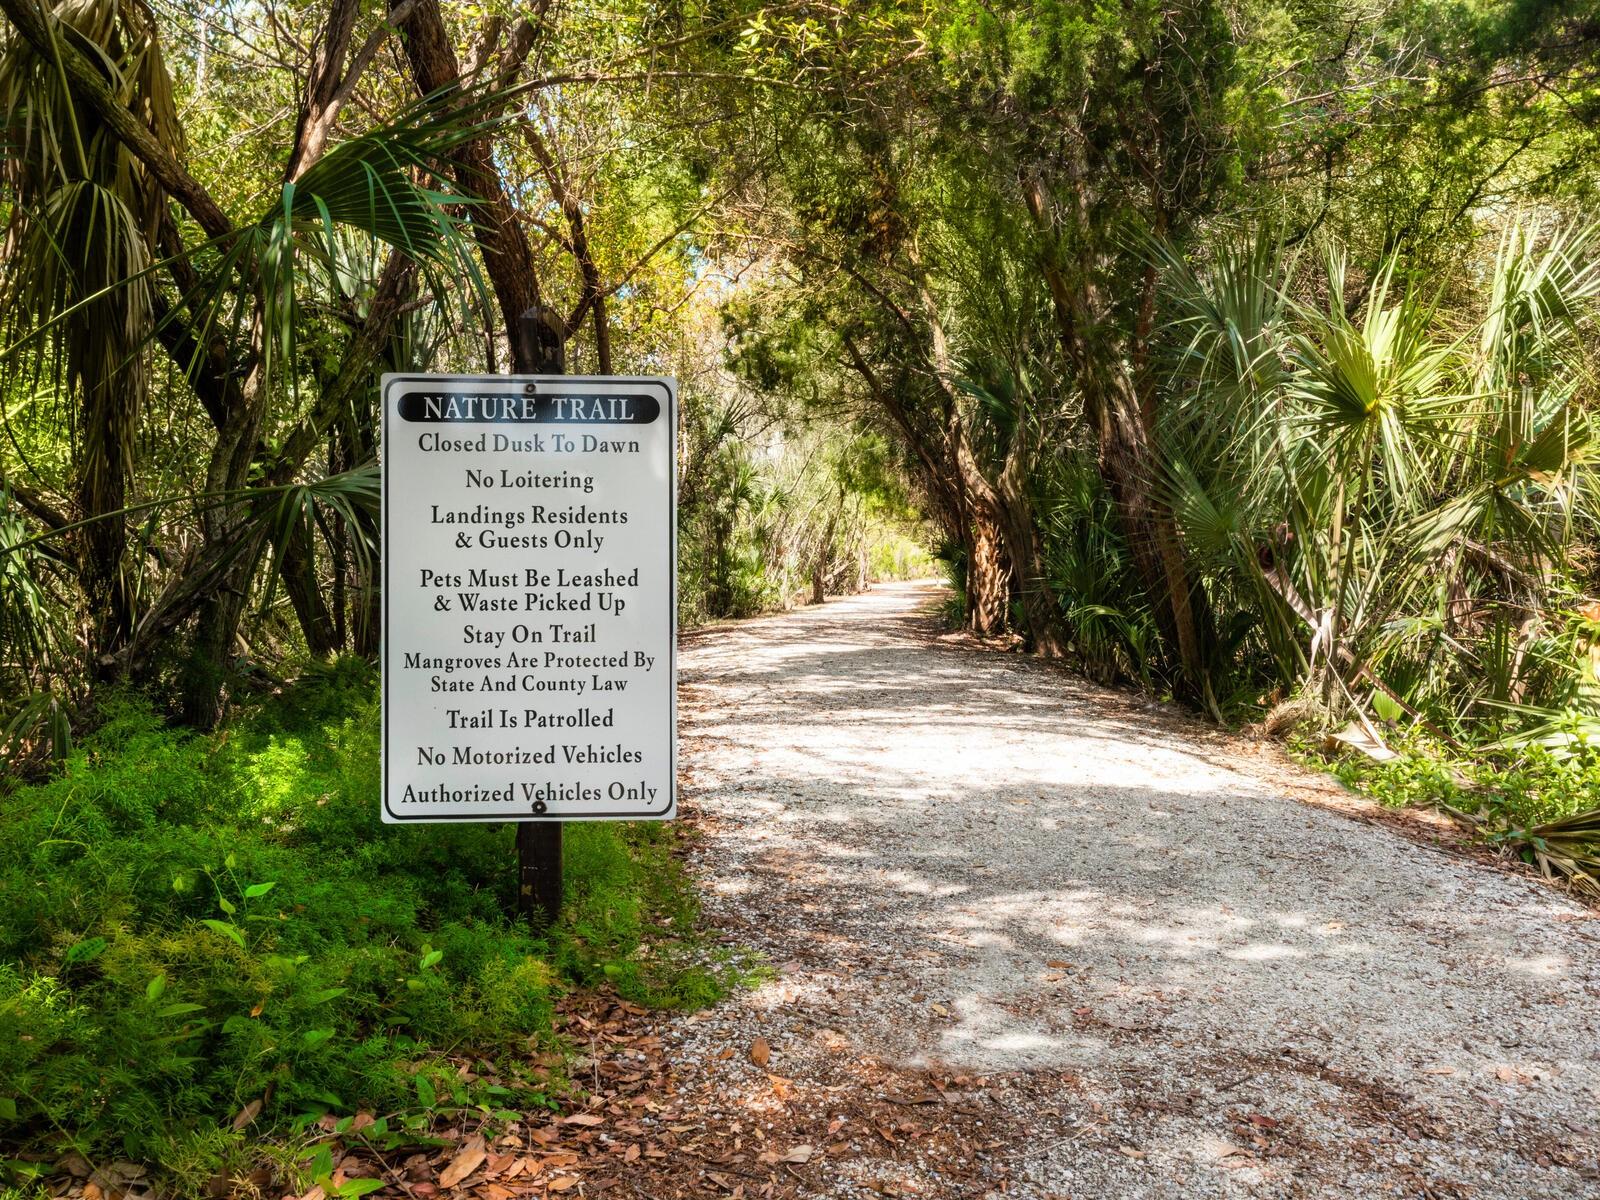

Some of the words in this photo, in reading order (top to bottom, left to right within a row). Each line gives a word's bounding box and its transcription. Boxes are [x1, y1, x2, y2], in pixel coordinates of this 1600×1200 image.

[424, 396, 536, 420] NATURE
[552, 398, 634, 420] TRAIL
[418, 433, 486, 452] Closed
[493, 434, 544, 452] Dusk
[552, 434, 576, 452] To
[582, 434, 640, 453] Dawn
[466, 470, 494, 488] No
[500, 470, 594, 493] Loitering
[432, 506, 525, 528] Landings
[532, 506, 628, 524] Residents
[456, 532, 472, 548] &
[479, 530, 548, 548] Guests
[554, 530, 604, 553] Only
[420, 569, 461, 588] Pets
[468, 569, 517, 588] Must
[524, 569, 550, 587] Be
[557, 568, 638, 587] Leashed
[434, 595, 452, 612] &
[458, 594, 518, 612] Waste
[524, 593, 591, 611] Picked
[598, 593, 625, 616] Up
[464, 625, 506, 648] Stay
[512, 625, 542, 644] On
[550, 624, 596, 643] Trail
[404, 653, 501, 672] Mangroves
[506, 652, 538, 668] Are
[544, 652, 628, 668] Protected
[634, 652, 655, 671] By
[431, 676, 474, 692] State
[480, 676, 516, 692] And
[522, 675, 586, 694] County
[592, 676, 628, 691] Law
[446, 710, 493, 728] Trail
[500, 710, 517, 728] Is
[524, 708, 614, 728] Patrolled
[418, 747, 446, 766] No
[452, 746, 555, 765] Motorized
[562, 744, 642, 764] Vehicles
[402, 783, 514, 804] Authorized
[521, 782, 601, 802] Vehicles
[608, 782, 657, 804] Only
